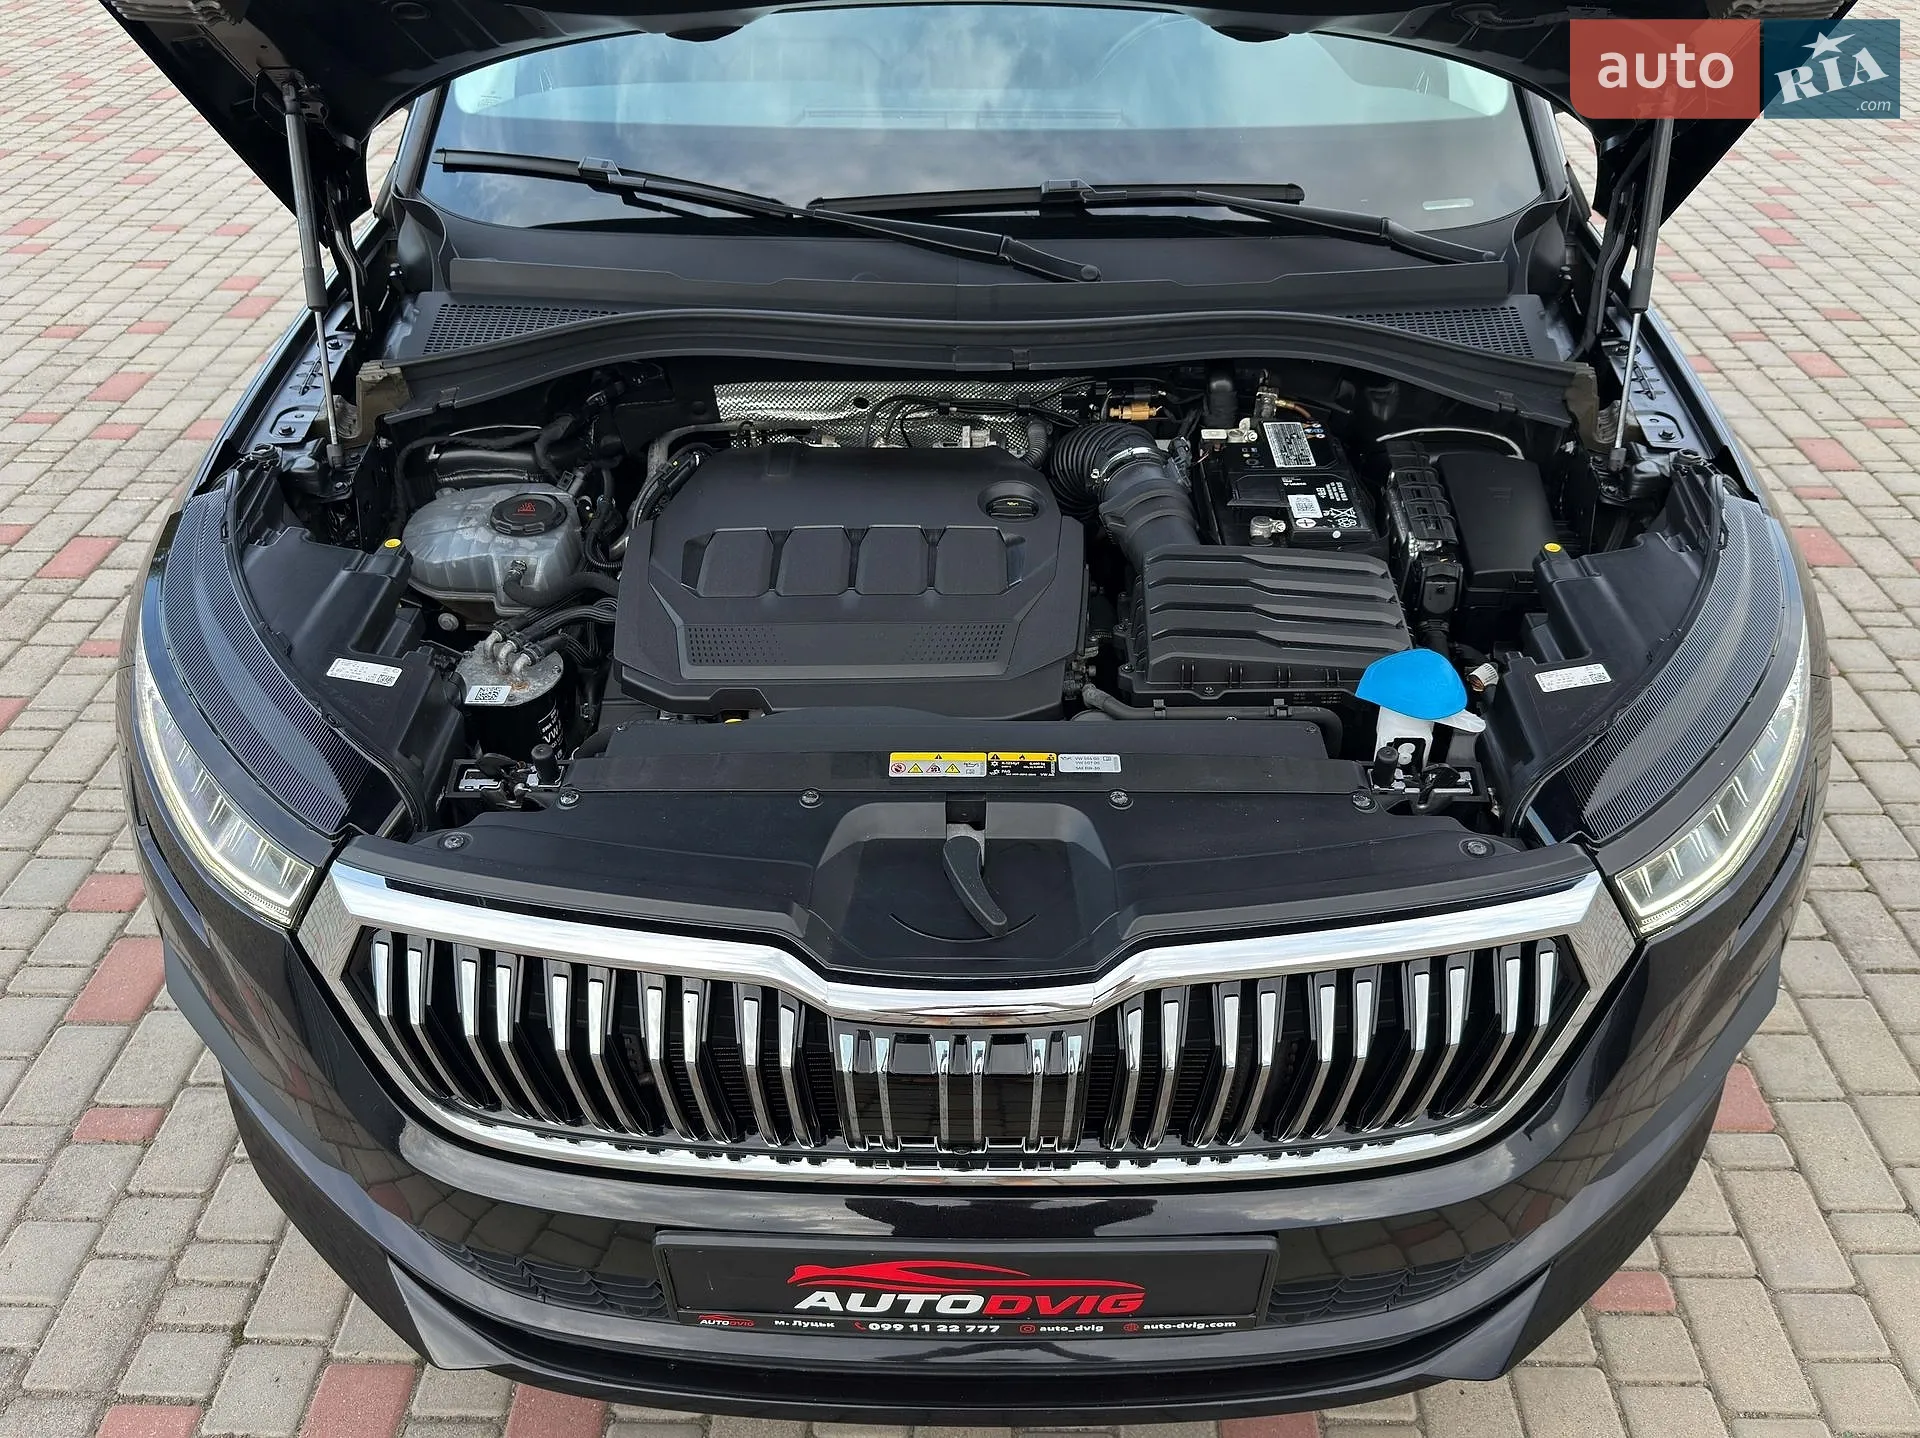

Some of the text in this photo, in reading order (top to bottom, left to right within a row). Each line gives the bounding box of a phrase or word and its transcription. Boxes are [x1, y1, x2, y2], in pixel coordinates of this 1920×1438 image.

[793, 1290, 1146, 1316] AUTODVIG
[791, 1319, 835, 1329] Луцьк
[868, 1323, 1001, 1332] 099 11 22 777
[1039, 1324, 1104, 1333] auto_dvig
[1142, 1320, 1237, 1331] auto-dvig.com
